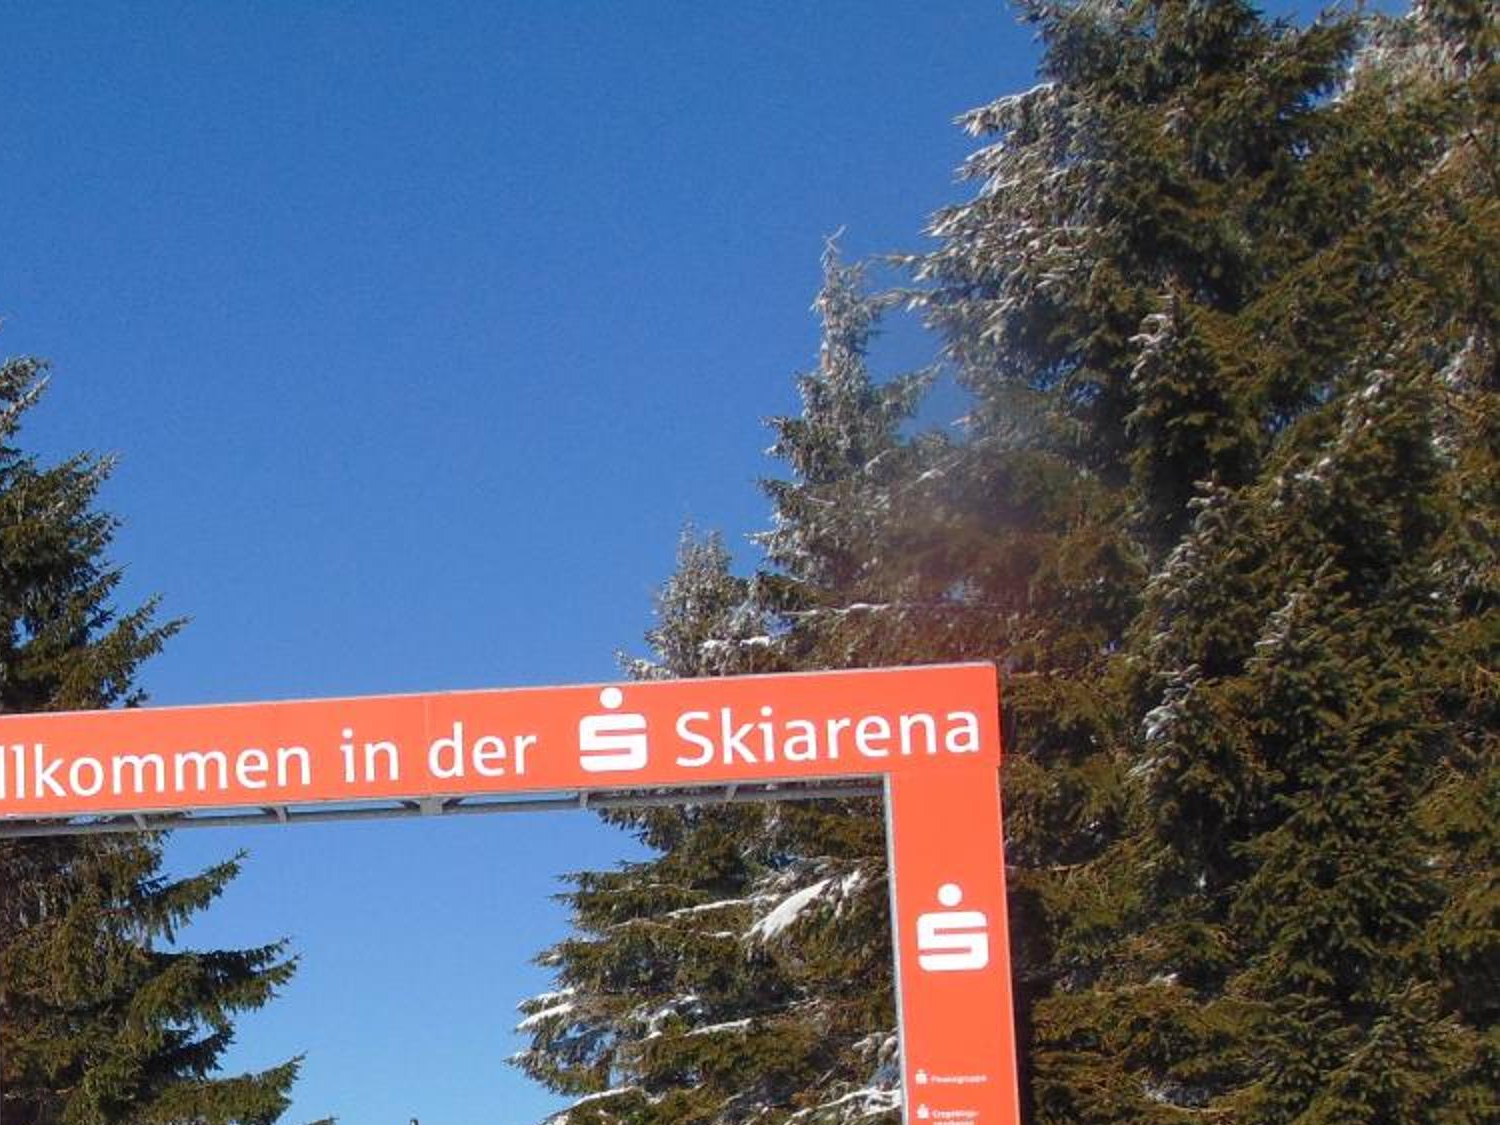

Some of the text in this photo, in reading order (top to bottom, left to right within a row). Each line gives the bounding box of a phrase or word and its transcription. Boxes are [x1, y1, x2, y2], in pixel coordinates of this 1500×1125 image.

[339, 728, 399, 783] in
[428, 721, 537, 779] der
[675, 706, 980, 767] Skiarena
